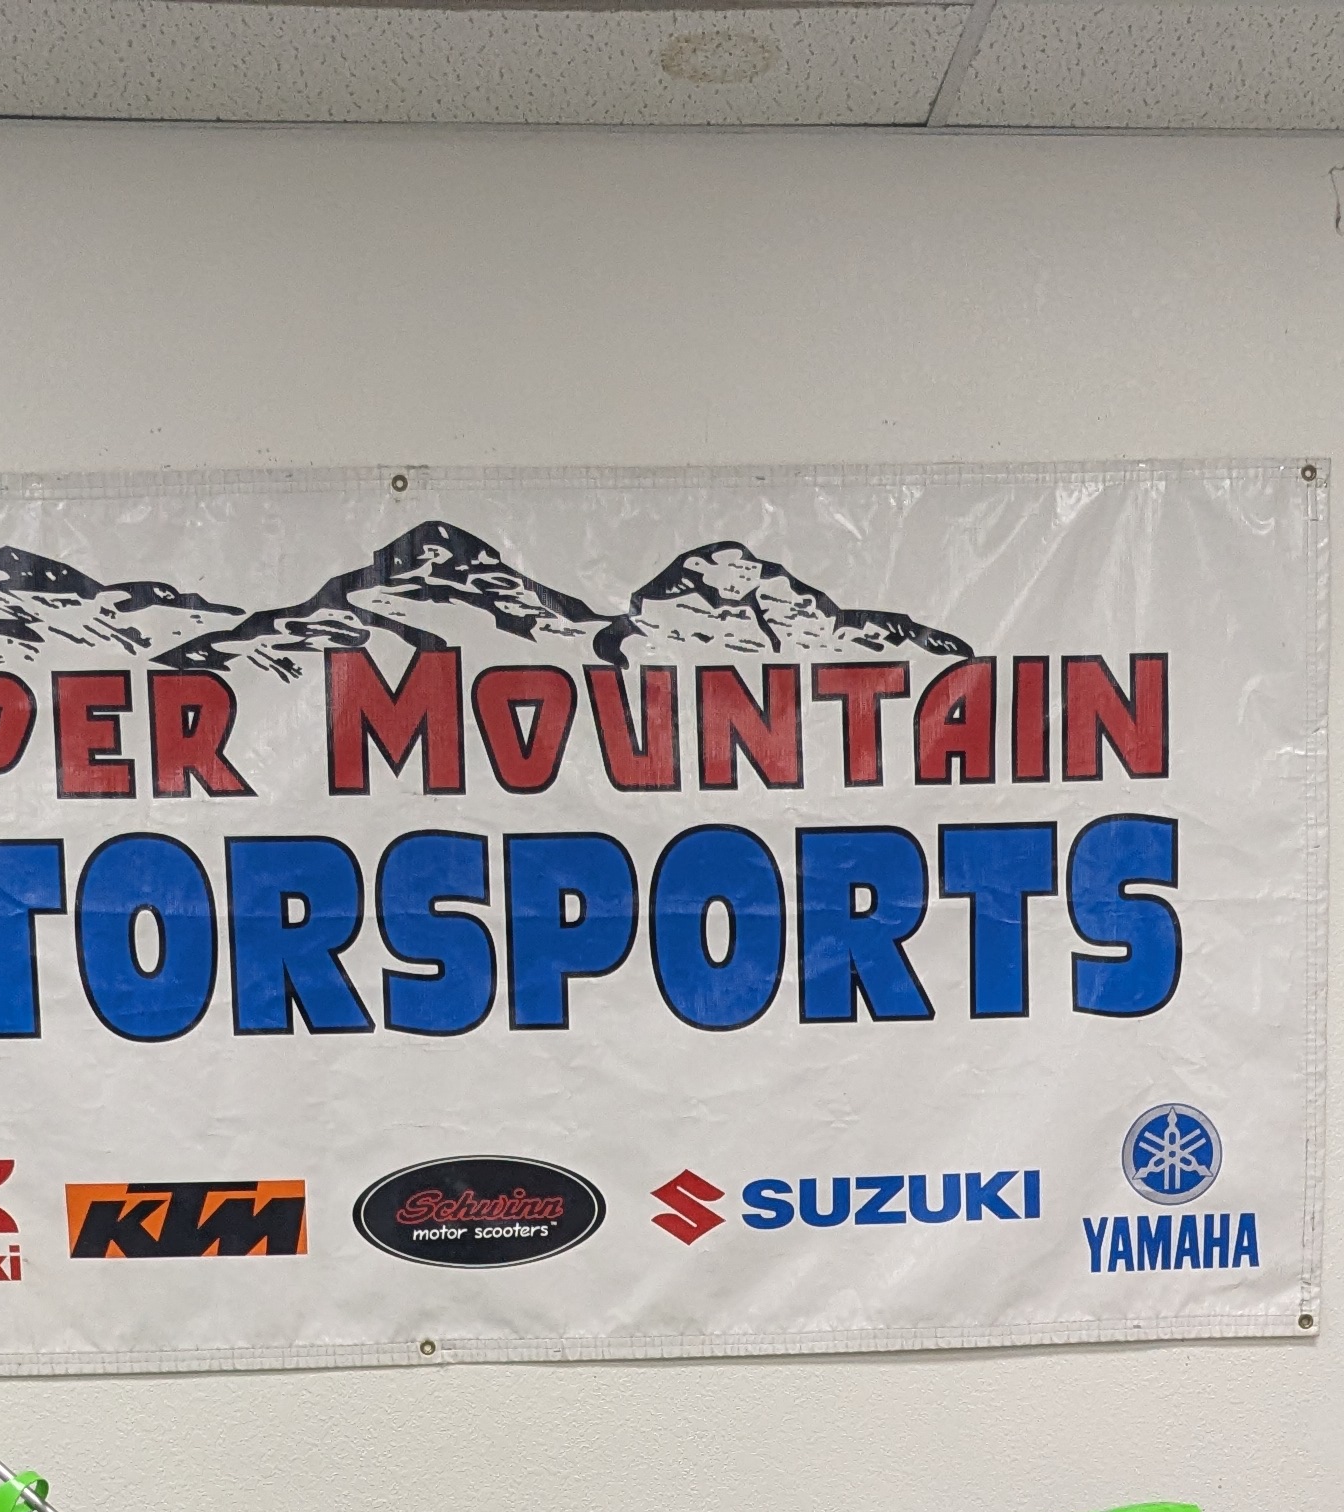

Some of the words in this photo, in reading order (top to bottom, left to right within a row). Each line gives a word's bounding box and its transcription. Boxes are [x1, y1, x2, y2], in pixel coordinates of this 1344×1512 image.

[324, 646, 1171, 796] MOUNTAIN
[71, 1181, 307, 1258] KTM
[395, 1187, 565, 1225] Schwinn
[741, 1169, 1042, 1230] SUZUKI
[412, 1224, 468, 1241] motor
[1082, 1212, 1261, 1273] YAMAHA
